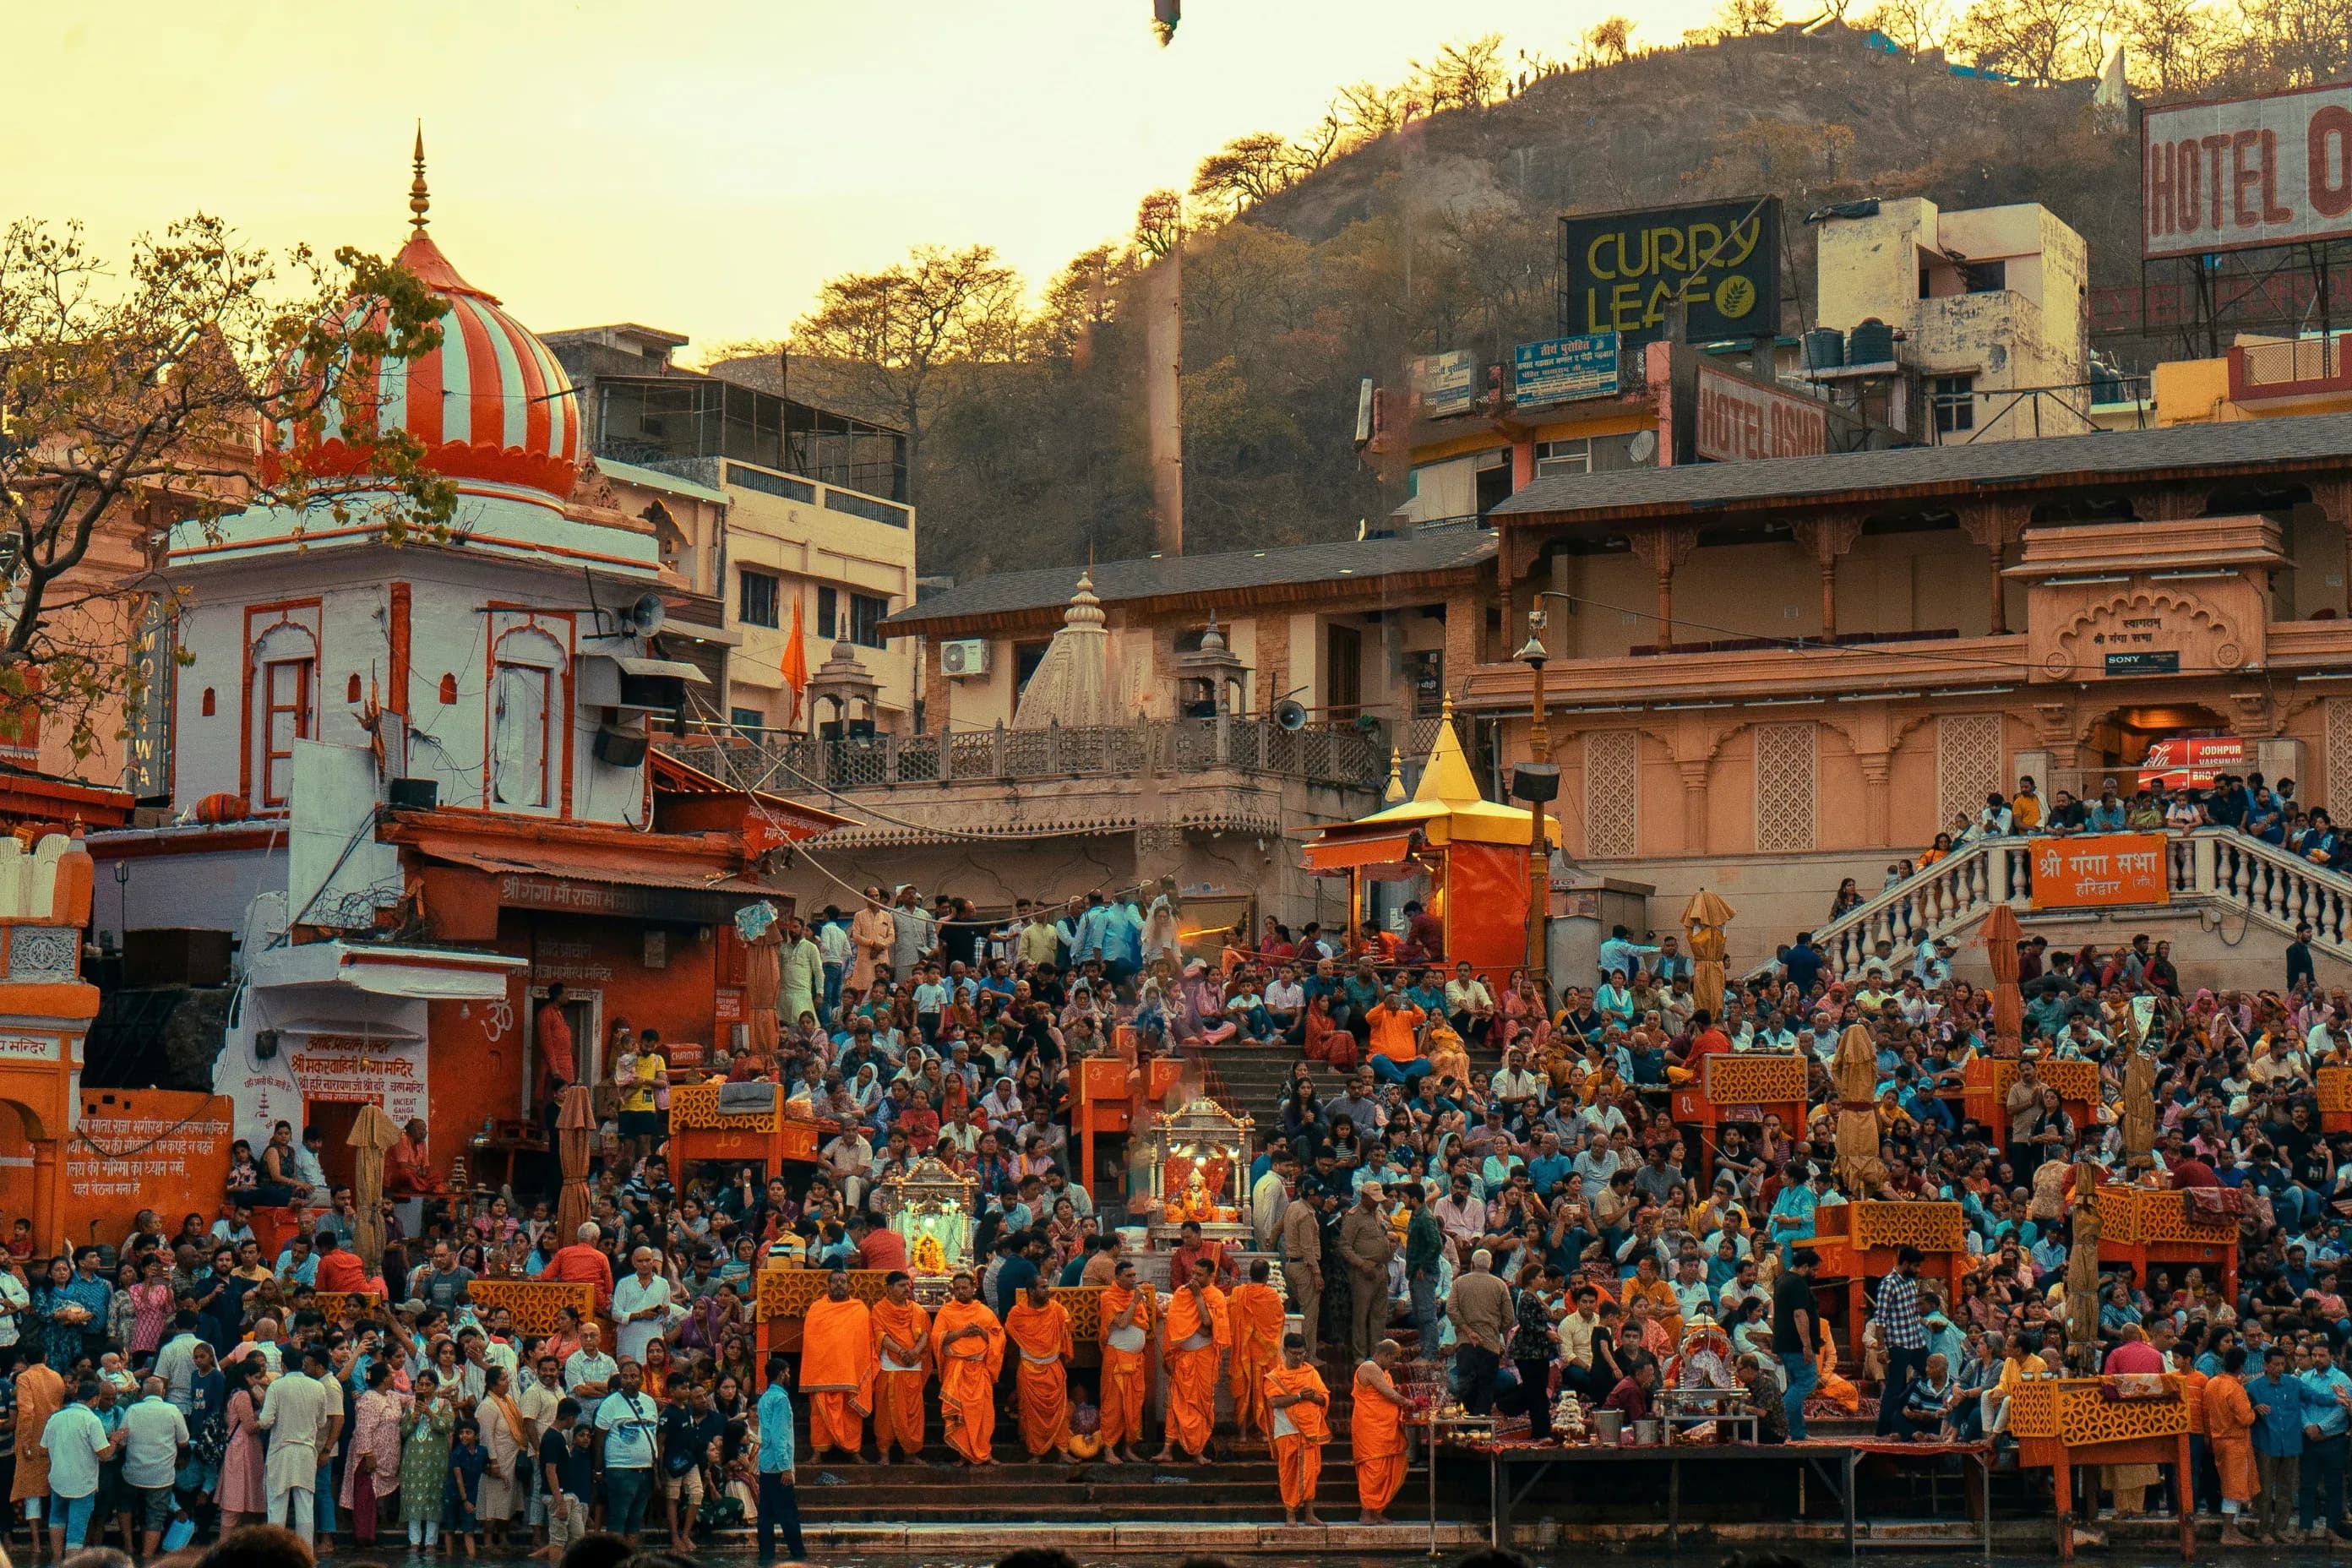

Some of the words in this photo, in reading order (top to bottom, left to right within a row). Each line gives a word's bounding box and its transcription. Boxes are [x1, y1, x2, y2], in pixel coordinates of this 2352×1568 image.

[2151, 128, 2294, 238] HOTEL
[1587, 217, 1761, 280] CURRY
[1588, 276, 1710, 334] LEAF
[2088, 286, 2197, 326] OTEL
[1703, 388, 1771, 460] HOTEL
[2122, 618, 2162, 630] स्वागतम्
[2094, 632, 2104, 644] श्री
[2109, 632, 2127, 643] गंगा
[2108, 656, 2140, 664] SONY
[2199, 745, 2241, 755] JODHPUR
[2039, 849, 2062, 878] श्री
[2069, 850, 2109, 877] गंगा
[2115, 852, 2157, 874] सभा
[573, 887, 603, 907] राजा
[2075, 877, 2121, 897] हरिद्वार
[9, 1037, 47, 1056] मन्दिर
[291, 1054, 305, 1073] श्री
[384, 1057, 414, 1079] मन्दिर
[393, 1098, 416, 1107] ANCIENT
